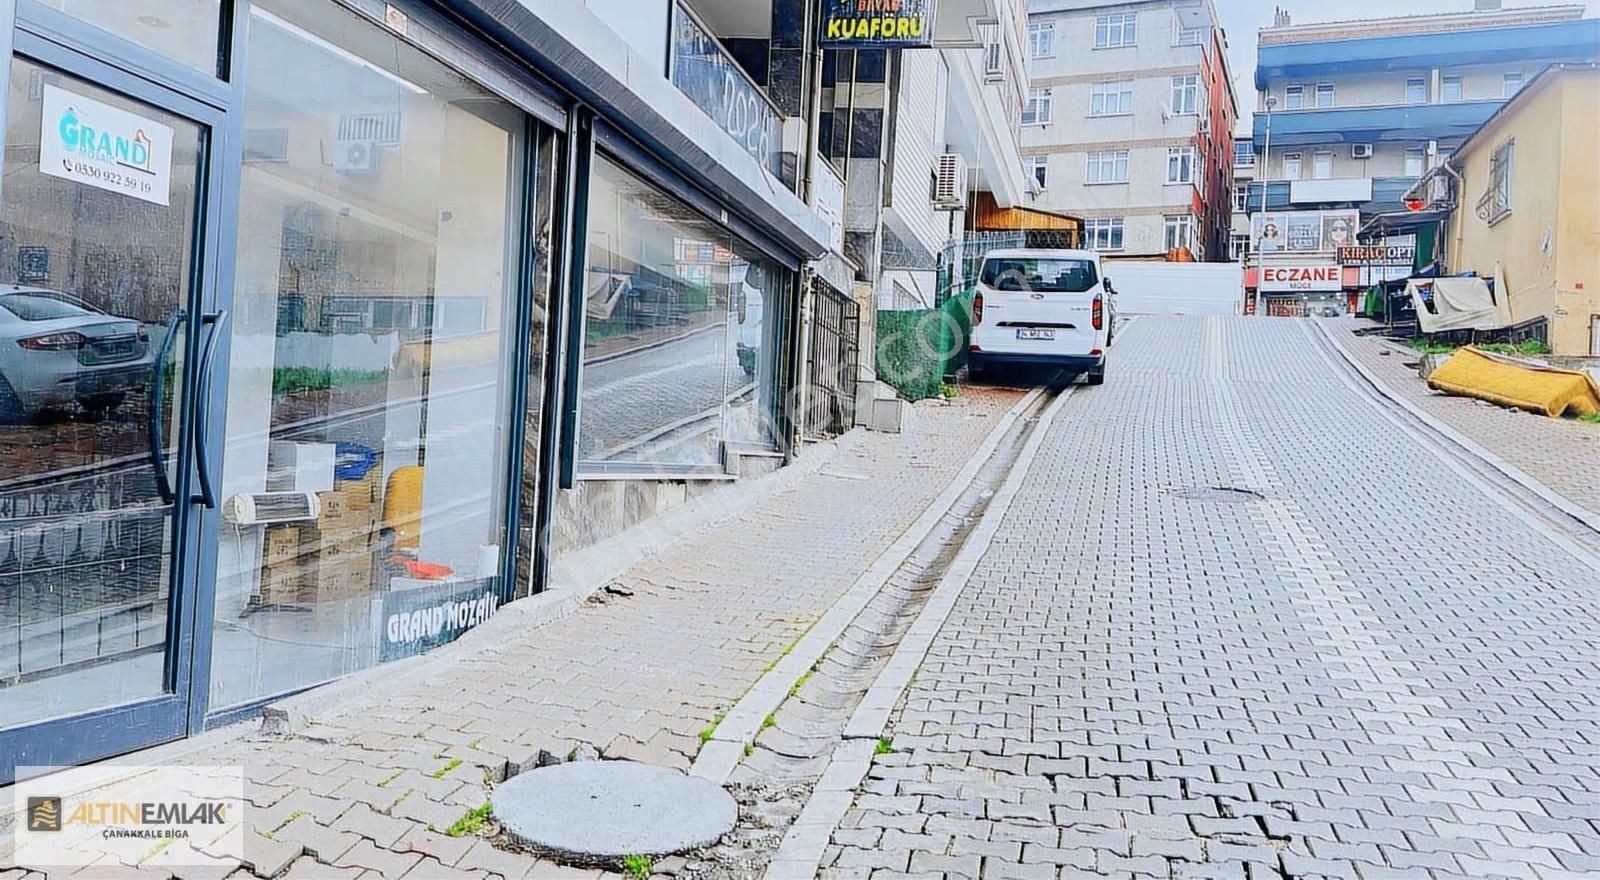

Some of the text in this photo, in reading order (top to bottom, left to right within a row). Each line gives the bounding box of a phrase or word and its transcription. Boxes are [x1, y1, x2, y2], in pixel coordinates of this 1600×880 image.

[827, 13, 924, 39] KUAFÖRÜ
[58, 109, 148, 165] GRAND
[74, 161, 101, 179] 0530
[103, 171, 122, 185] 922
[139, 181, 152, 194] 19
[1263, 268, 1338, 282] ECZANE
[387, 605, 445, 643] GRAND
